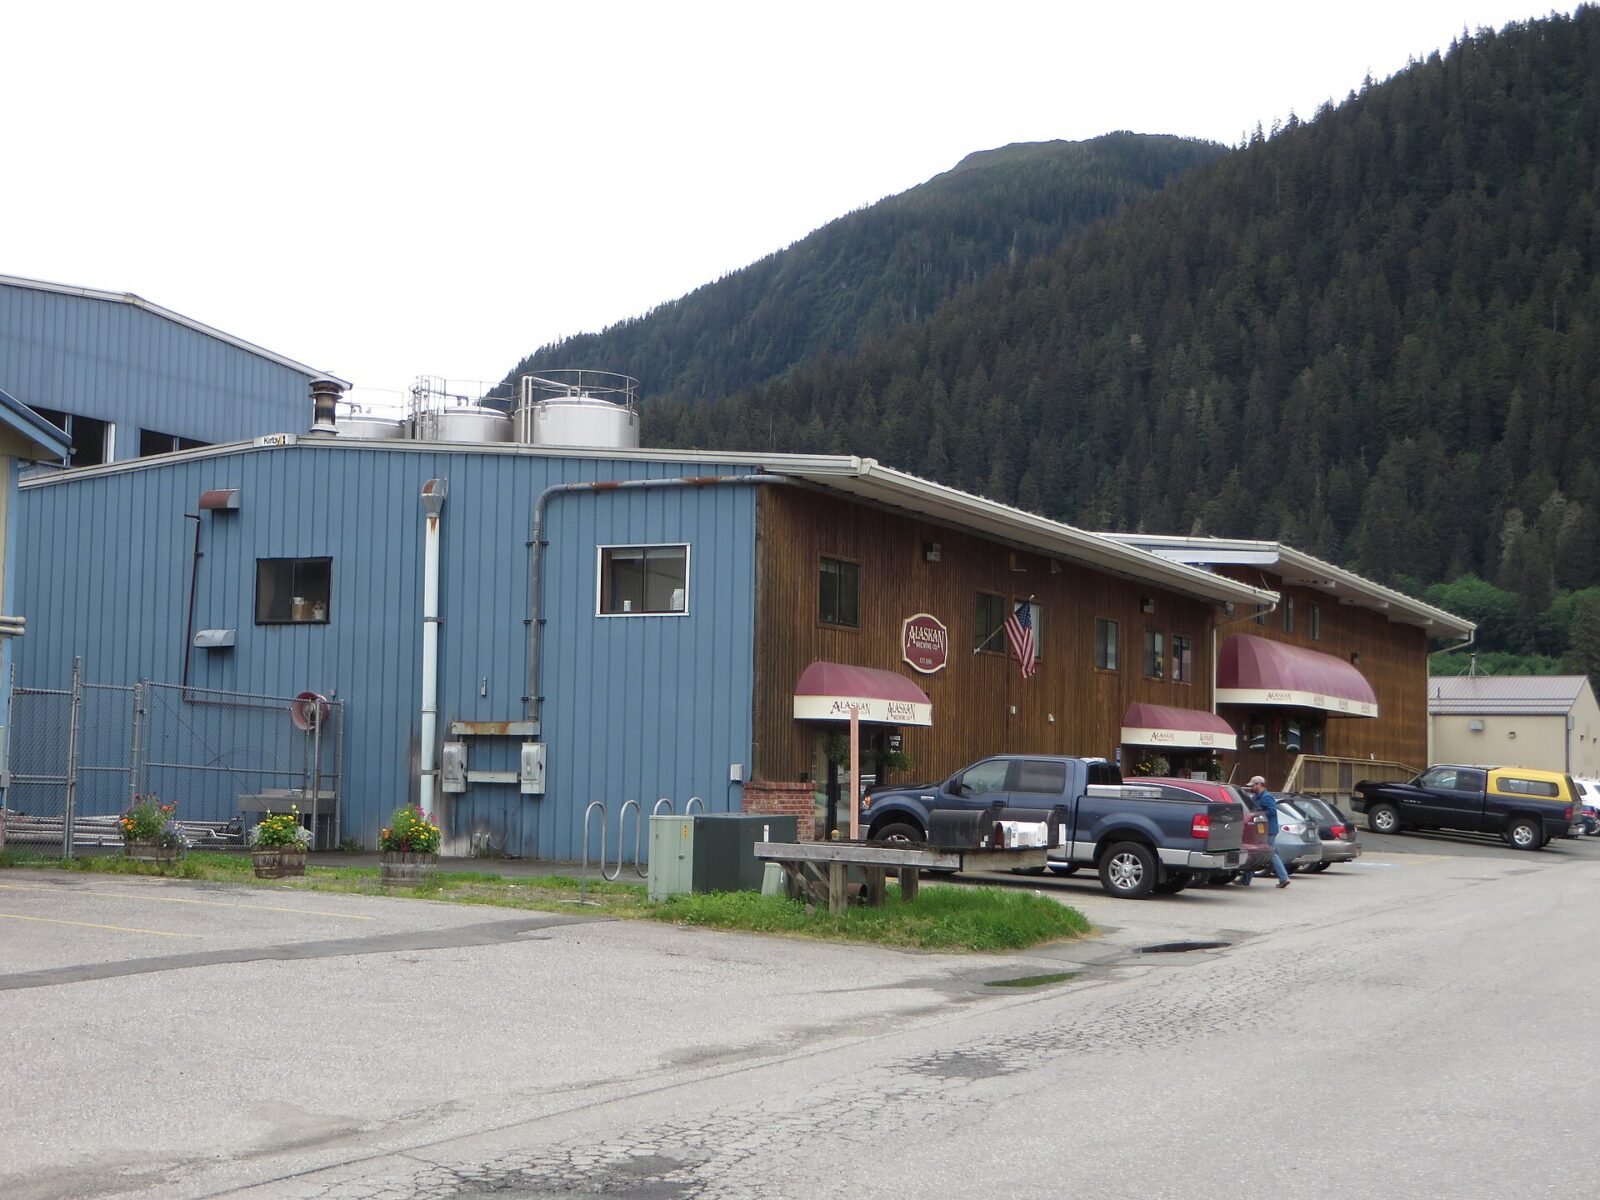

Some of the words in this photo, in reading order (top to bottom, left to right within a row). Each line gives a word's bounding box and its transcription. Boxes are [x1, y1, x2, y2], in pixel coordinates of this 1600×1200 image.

[906, 625, 945, 656] ALASKAN
[830, 701, 871, 716] ALASKAN
[886, 702, 916, 722] ALASKAN
